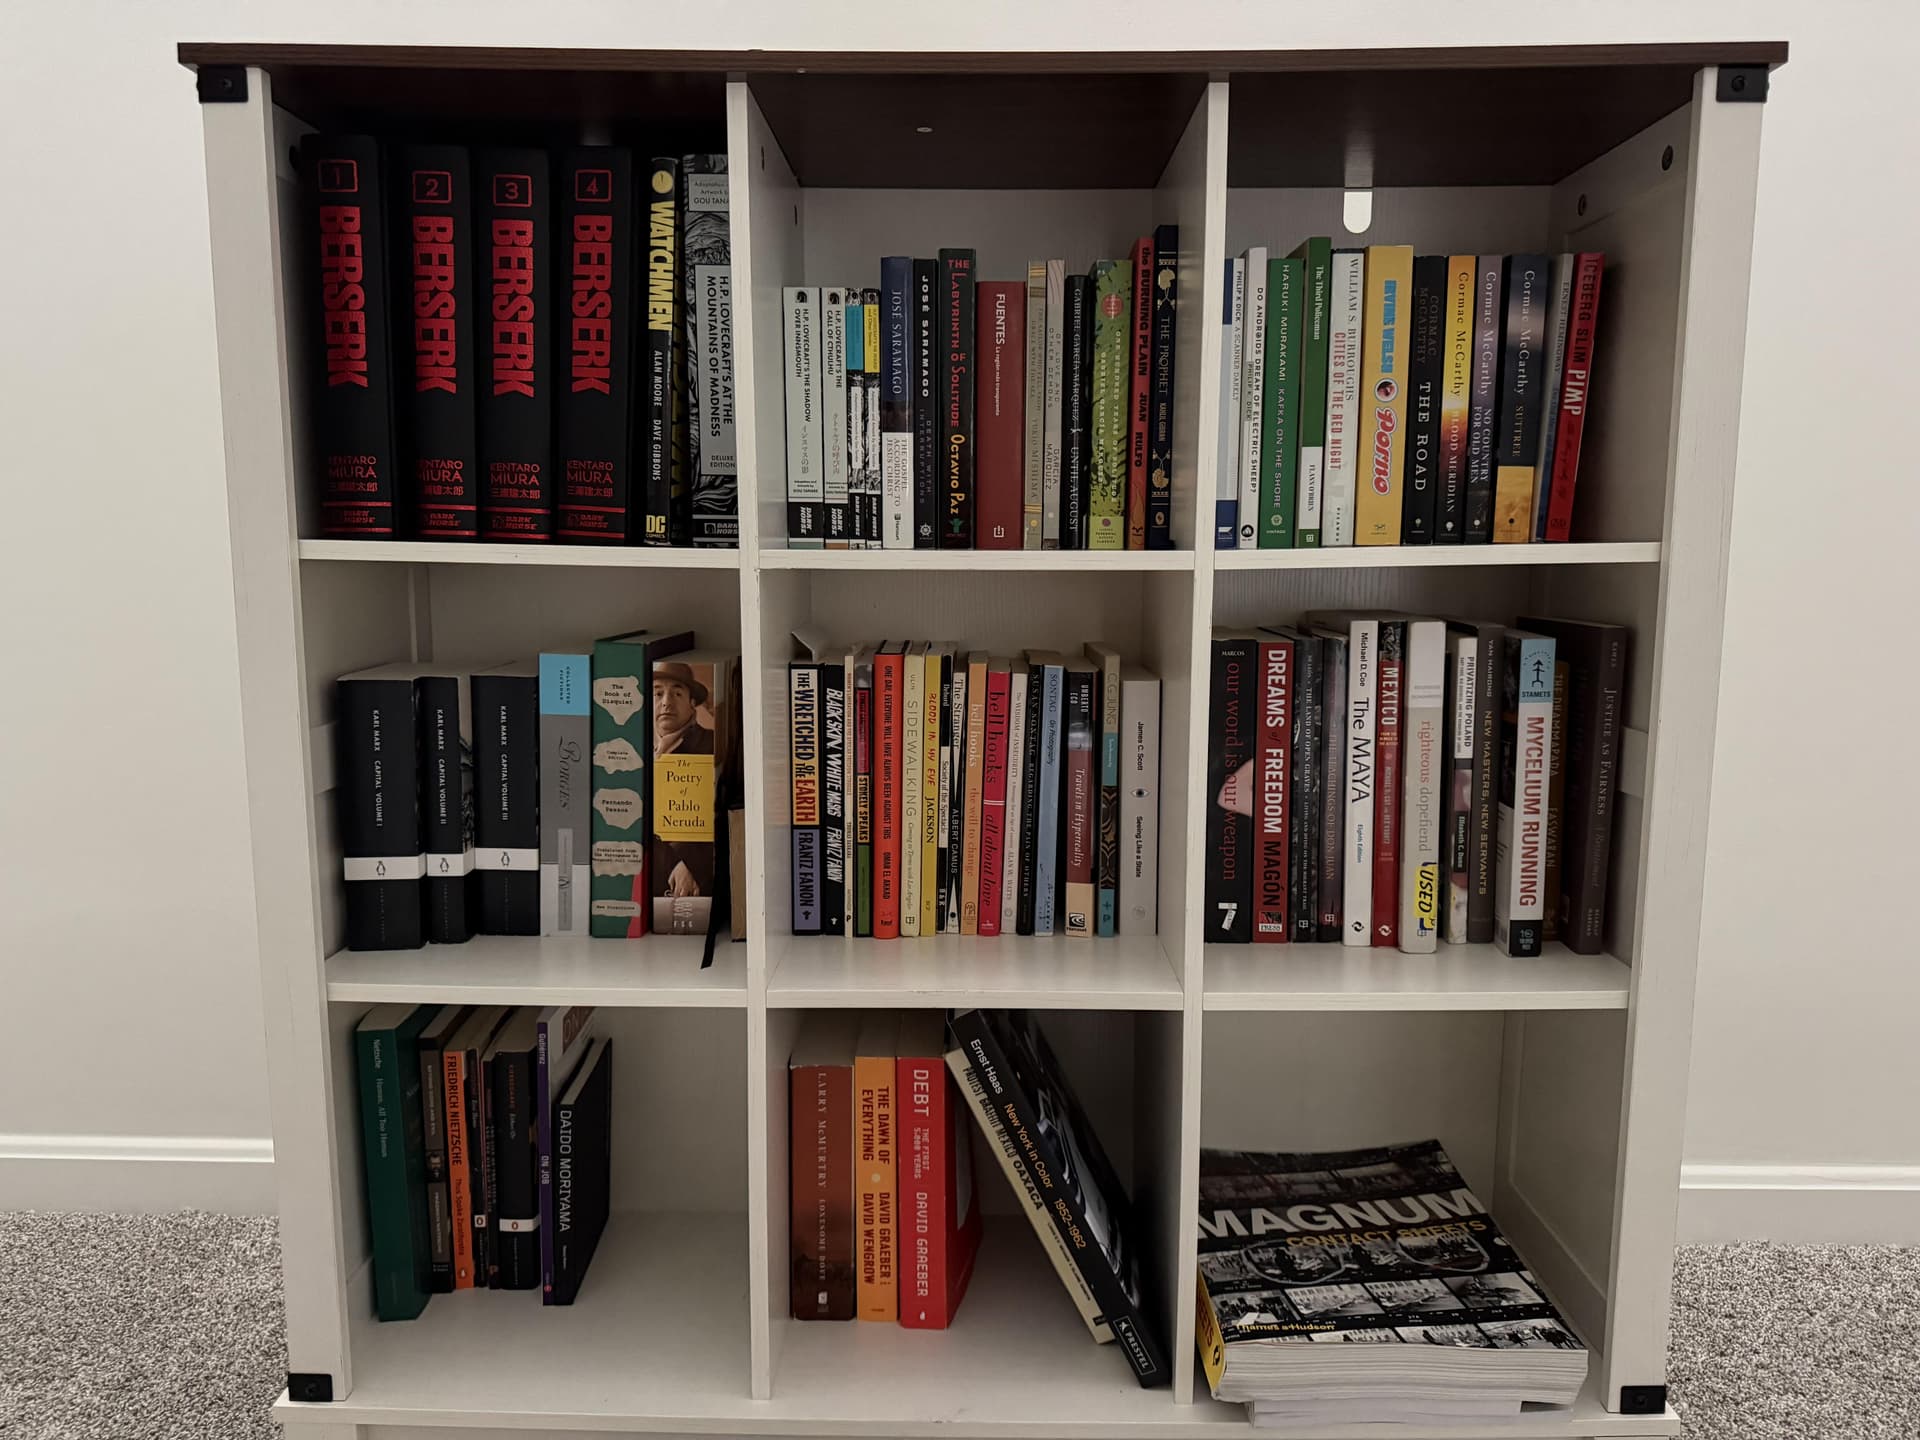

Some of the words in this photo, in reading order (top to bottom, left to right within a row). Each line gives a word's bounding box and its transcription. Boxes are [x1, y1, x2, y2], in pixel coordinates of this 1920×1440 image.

[426, 179, 438, 196] 2
[505, 182, 518, 198] 3
[586, 179, 599, 195] 4
[649, 201, 675, 331] WATCHMEN
[948, 260, 970, 269] THE
[1141, 247, 1150, 265] the
[1316, 265, 1324, 280] The
[320, 205, 368, 387] BERSERK
[412, 216, 456, 394] BERSERK
[572, 215, 612, 395] BERSERK
[891, 290, 903, 319] JOSÉ
[922, 275, 930, 312] JOSÉ
[1140, 270, 1150, 330] BURNING
[1315, 282, 1323, 301] Third
[1484, 272, 1496, 323] Cormac
[1579, 258, 1598, 320] ICEBERG
[491, 218, 534, 398] BERSERK
[951, 273, 967, 348] LABYRINTH
[1313, 303, 1322, 340] Policeman
[1161, 317, 1170, 339] THE
[1573, 328, 1589, 362] SLIM
[653, 350, 663, 372] ALAN
[892, 324, 901, 394] SARAMAGO
[951, 353, 966, 361] OF
[1138, 335, 1148, 375] PLAIN
[1334, 332, 1345, 367] CITIES
[1479, 330, 1493, 396] McCarthy
[1159, 345, 1170, 396] PROPHET
[1333, 372, 1344, 385] OF
[653, 376, 663, 407] MOORE
[951, 366, 966, 427] SOLITUDE
[1332, 390, 1344, 408] THE
[1418, 382, 1431, 422] THE
[1562, 369, 1586, 415] PIMP
[652, 419, 662, 440] DAVE
[1331, 414, 1342, 433] RED
[1473, 407, 1482, 427] FOR
[1483, 409, 1492, 424] NO
[1135, 433, 1143, 466] RULFO
[1330, 439, 1342, 470] NIGHT
[1373, 408, 1397, 495] Porno
[1471, 432, 1481, 454] OLD
[1480, 428, 1491, 482] COUNTRY
[490, 463, 540, 472] KENTARO
[567, 470, 613, 484] MIURA
[652, 444, 661, 480] GIBBONS
[951, 435, 965, 488] OCTAVIO
[1070, 447, 1079, 483] UNTIL
[1414, 434, 1428, 491] ROAD
[1470, 459, 1479, 483] MEN
[895, 495, 900, 506] TO
[951, 493, 965, 514] PAZ
[1069, 486, 1078, 531] AUGUST
[645, 514, 666, 533] DC
[954, 680, 963, 699] The
[1228, 663, 1240, 694] our
[1381, 667, 1398, 725] MEXICO
[1465, 657, 1474, 710] PRIVATIZING
[988, 692, 1005, 724] bell
[1070, 693, 1078, 704] ECO
[1081, 685, 1089, 712] UMBERTO
[1353, 697, 1369, 730] The
[952, 703, 962, 748] Stranger
[1225, 699, 1242, 746] word
[1464, 714, 1472, 746] POLAND
[906, 701, 918, 816] SIDEWALKING
[986, 731, 1003, 783] hooks
[1225, 754, 1240, 767] is
[1417, 721, 1434, 783] righteous
[1524, 717, 1544, 814] MYCELIUM
[667, 771, 702, 785] Poetry
[1075, 769, 1085, 798] Travels
[1352, 737, 1370, 803] MAYA
[668, 800, 700, 812] Pablo
[859, 777, 870, 808] STOKELY
[1075, 801, 1083, 810] in
[1223, 774, 1237, 804] our
[663, 816, 705, 827] Neruda
[859, 811, 869, 840] SPEAKS
[987, 814, 1001, 833] all
[1418, 787, 1432, 851] dopefiend
[799, 832, 813, 869] FRANTZ
[984, 837, 1000, 876] about
[1072, 813, 1084, 867] Hyperreality
[1220, 811, 1237, 880] weapon
[1520, 821, 1539, 906] RUNNING
[799, 872, 814, 906] FANON
[982, 879, 998, 906] love
[1419, 870, 1433, 912] USED
[447, 1055, 459, 1108] FRIEDRICH
[878, 1086, 889, 1108] THE
[914, 1069, 929, 1116] DEBT
[450, 1111, 463, 1165] NIETZSCHE
[560, 1110, 572, 1154] DAIDO
[863, 1089, 873, 1160] EVERYTHING
[878, 1114, 889, 1145] DAWN
[879, 1150, 889, 1164] OF
[454, 1178, 462, 1195] Thus
[560, 1158, 571, 1232] MORIYAMA
[864, 1193, 874, 1224] DAVID
[880, 1193, 890, 1223] DAVID
[917, 1192, 927, 1232] DAVID
[1198, 1188, 1488, 1239] MAGNUM
[457, 1218, 465, 1255] Zarathustra
[1286, 1231, 1391, 1246] CONTACT
[1397, 1220, 1487, 1238] SHEETS
[864, 1229, 874, 1284] WENGROW
[880, 1228, 891, 1278] GRAEBER
[917, 1238, 928, 1296] GRAEBER
[1125, 1332, 1148, 1368] PRESTEL
